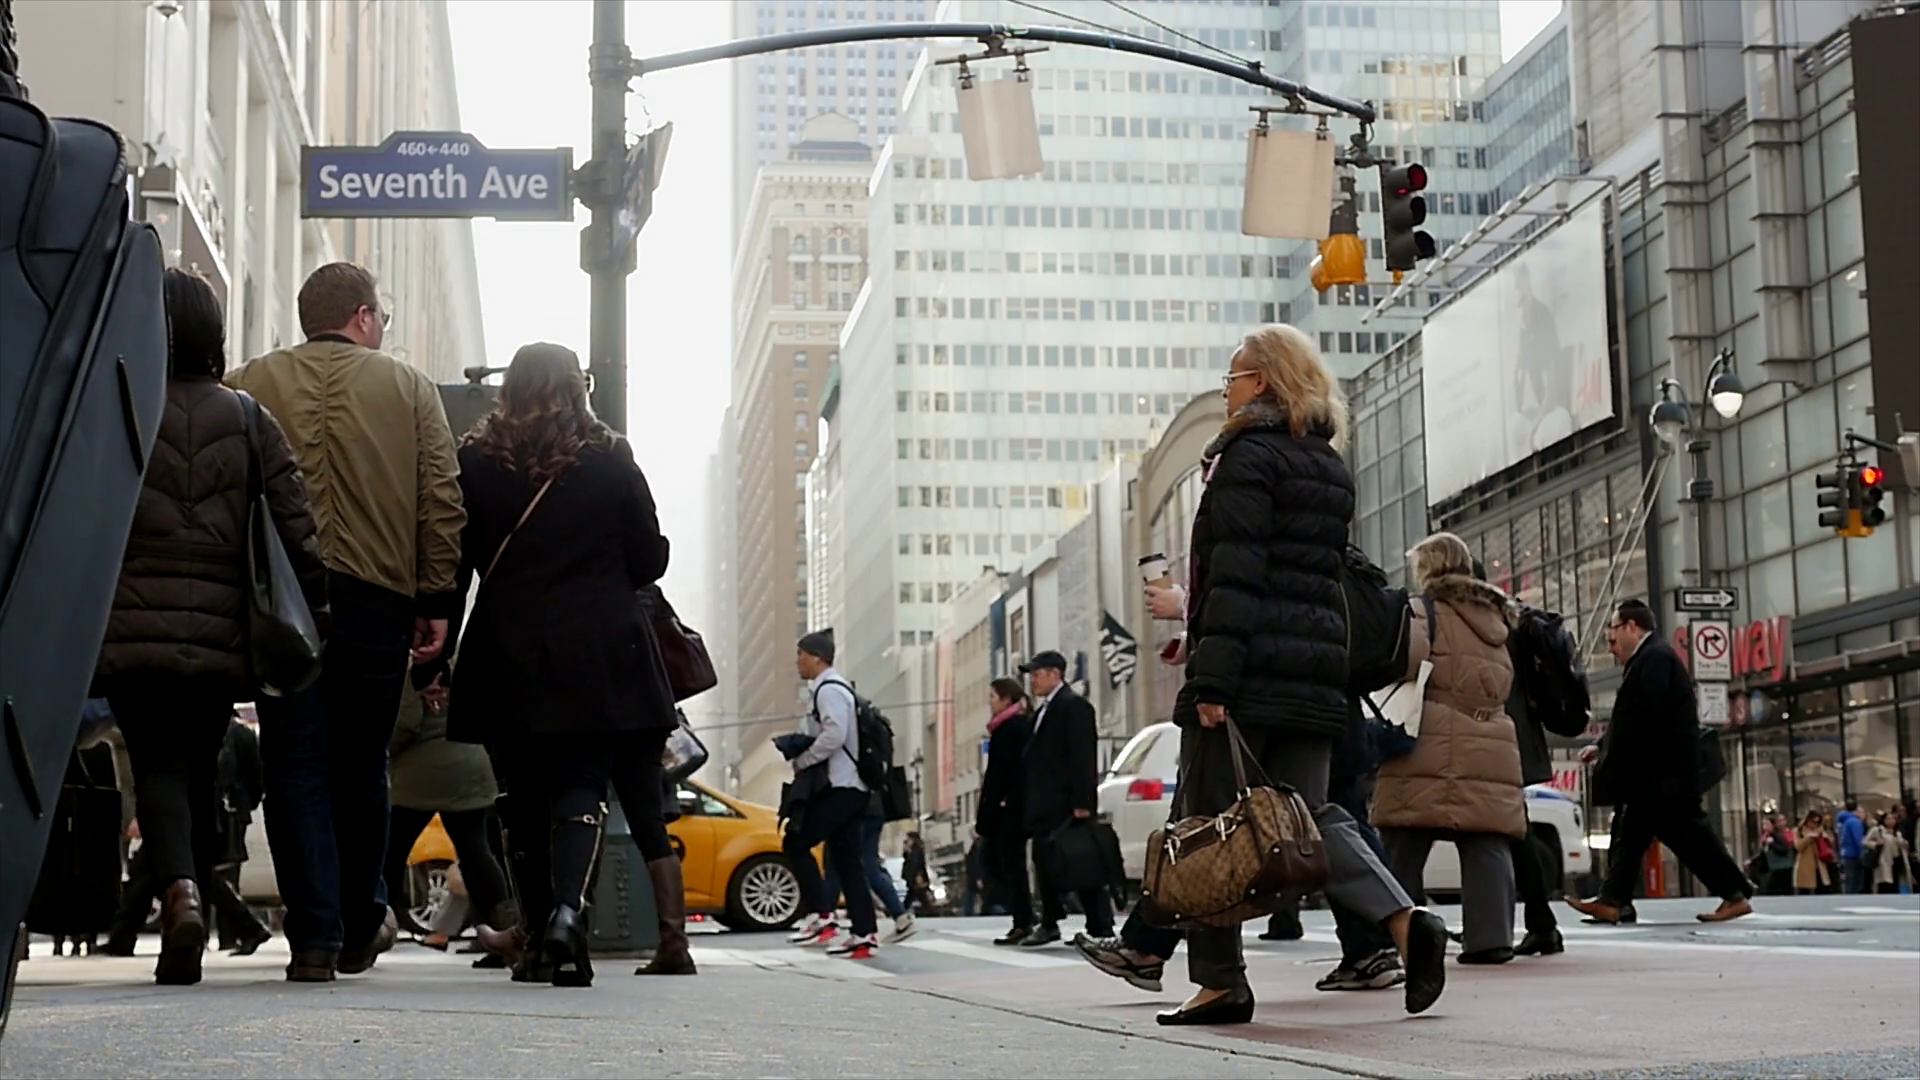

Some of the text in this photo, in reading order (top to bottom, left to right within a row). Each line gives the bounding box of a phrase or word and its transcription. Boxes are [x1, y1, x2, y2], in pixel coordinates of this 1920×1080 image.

[397, 142, 470, 157] 460 440
[318, 163, 549, 200] Seventh Ave
